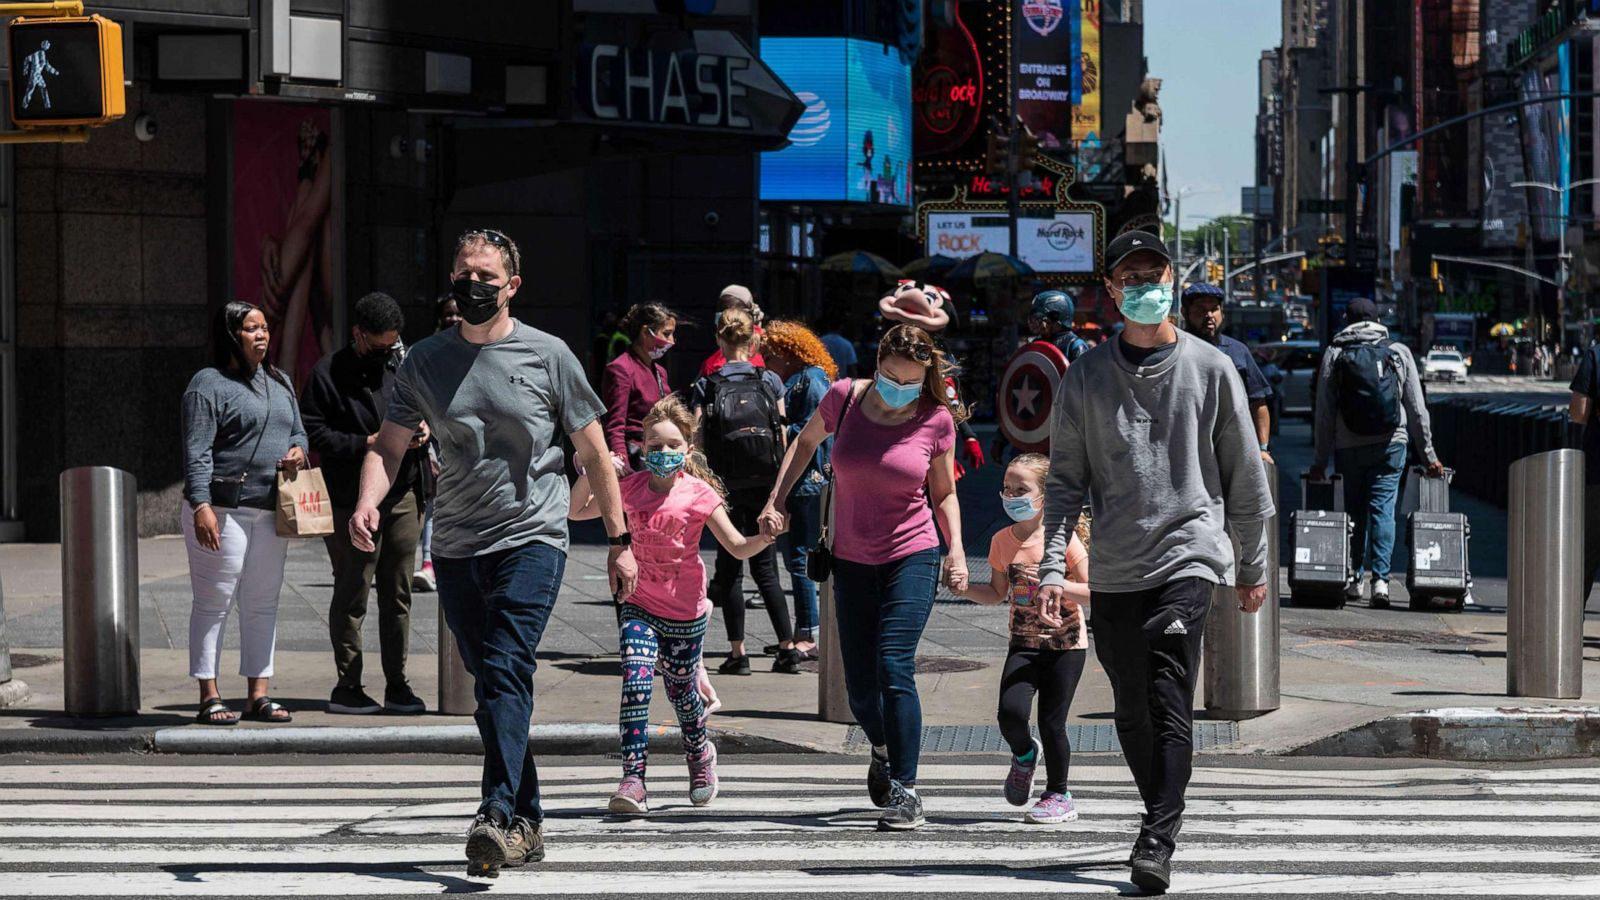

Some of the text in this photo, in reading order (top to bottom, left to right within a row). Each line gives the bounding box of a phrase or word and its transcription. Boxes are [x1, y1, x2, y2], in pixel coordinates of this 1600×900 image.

[1019, 63, 1067, 75] ENTRANCE
[591, 44, 751, 127] CHASE
[1035, 77, 1051, 88] ON
[1018, 89, 1069, 101] BROADWAY
[1037, 227, 1085, 240] Hard Rock
[937, 233, 981, 251] ROCK
